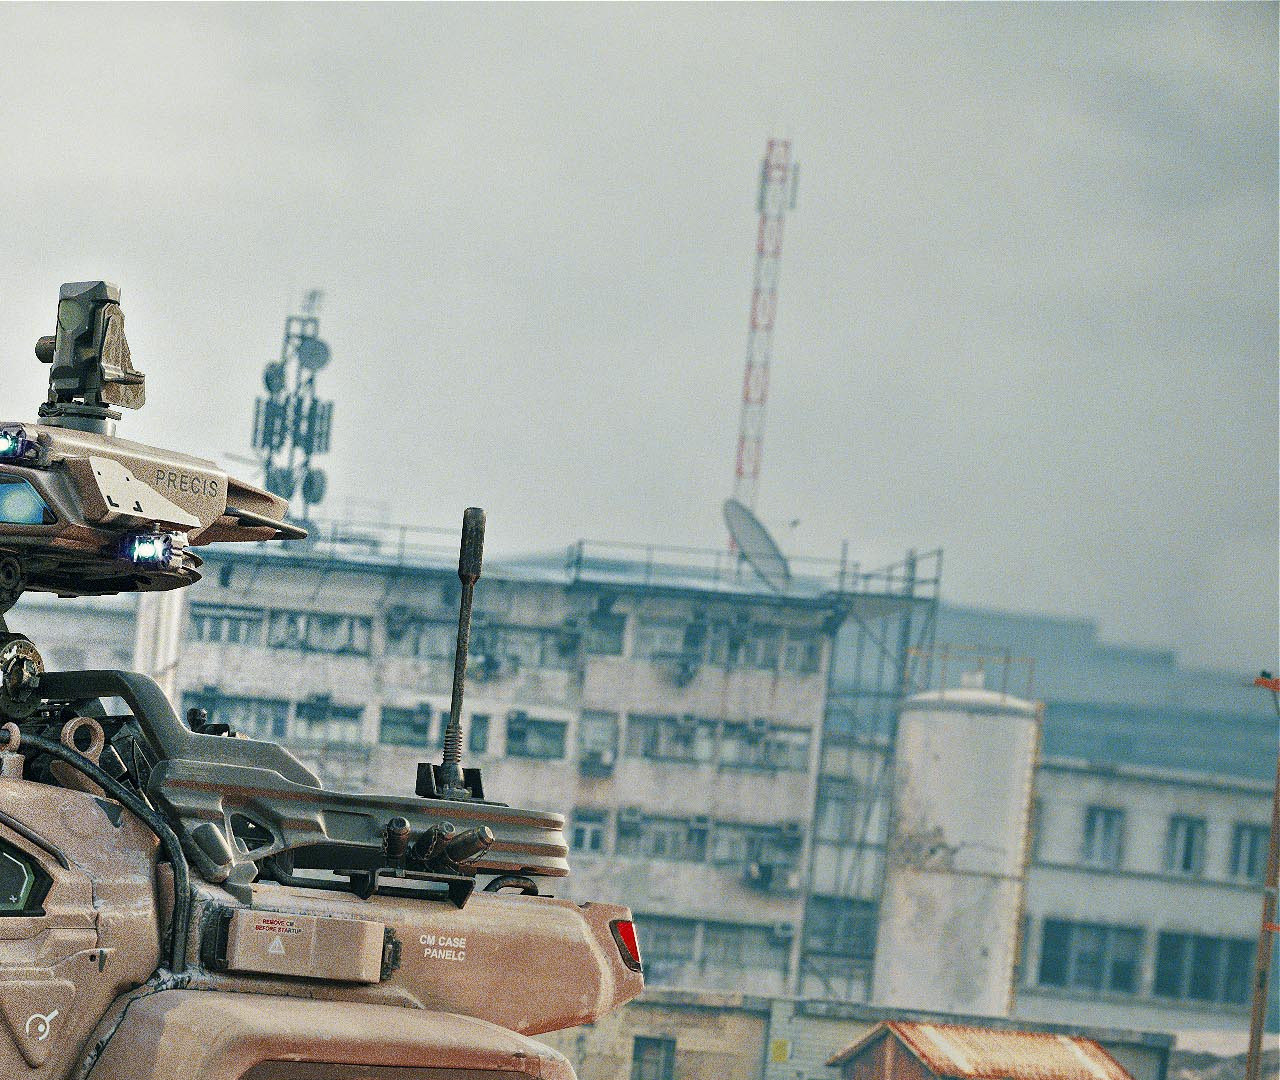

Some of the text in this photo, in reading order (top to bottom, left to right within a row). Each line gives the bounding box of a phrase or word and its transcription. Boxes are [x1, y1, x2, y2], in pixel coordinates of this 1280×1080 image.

[155, 469, 219, 498] PRECIS
[262, 918, 285, 926] REMOVE
[255, 924, 277, 932] BEFORE
[419, 934, 467, 949] CM CASE
